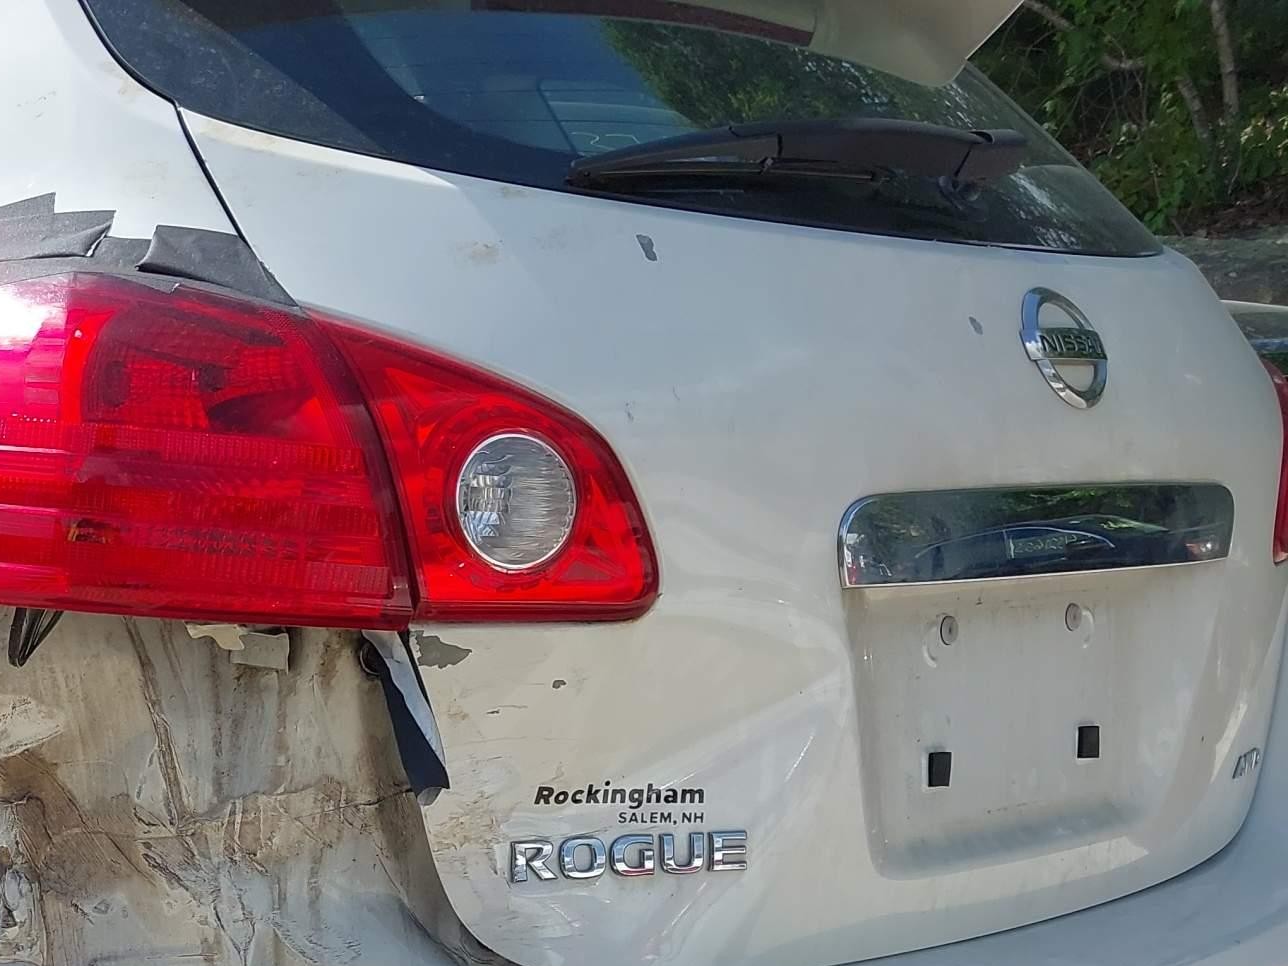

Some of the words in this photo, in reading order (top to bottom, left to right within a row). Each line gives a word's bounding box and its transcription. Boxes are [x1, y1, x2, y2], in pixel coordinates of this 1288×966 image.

[533, 780, 705, 809] Rockingham
[617, 811, 677, 825] SALEM,
[681, 811, 705, 824] NH
[510, 830, 748, 883] ROGUE
